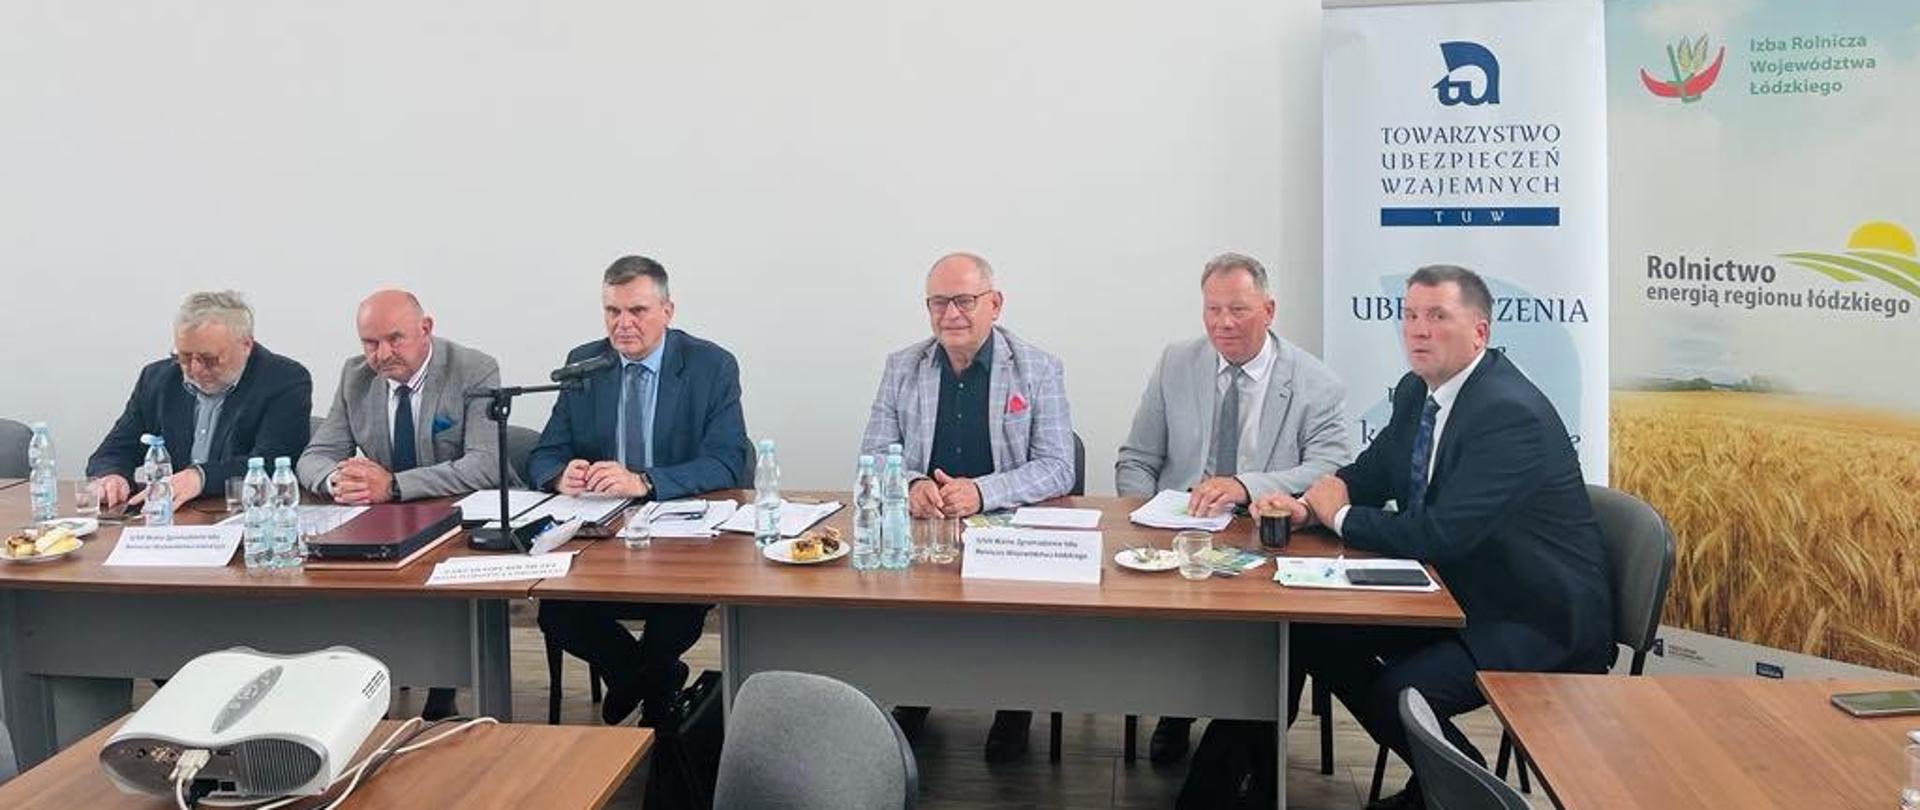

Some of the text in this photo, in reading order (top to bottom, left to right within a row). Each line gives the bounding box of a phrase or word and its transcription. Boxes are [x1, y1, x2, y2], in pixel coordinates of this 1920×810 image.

[1750, 34, 1867, 52] Izba Rolnicza
[1750, 57, 1876, 75] Województwa
[1750, 79, 1843, 96] Łódzkiego
[1381, 124, 1561, 145] TOWARZYSTWO
[1381, 146, 1560, 169] UBEZPIECZEŃ
[1381, 176, 1560, 197] WZAJEMNYCH
[1646, 255, 1776, 283] Rolnictwo
[1646, 284, 1911, 318] energią regionu łódzkiego
